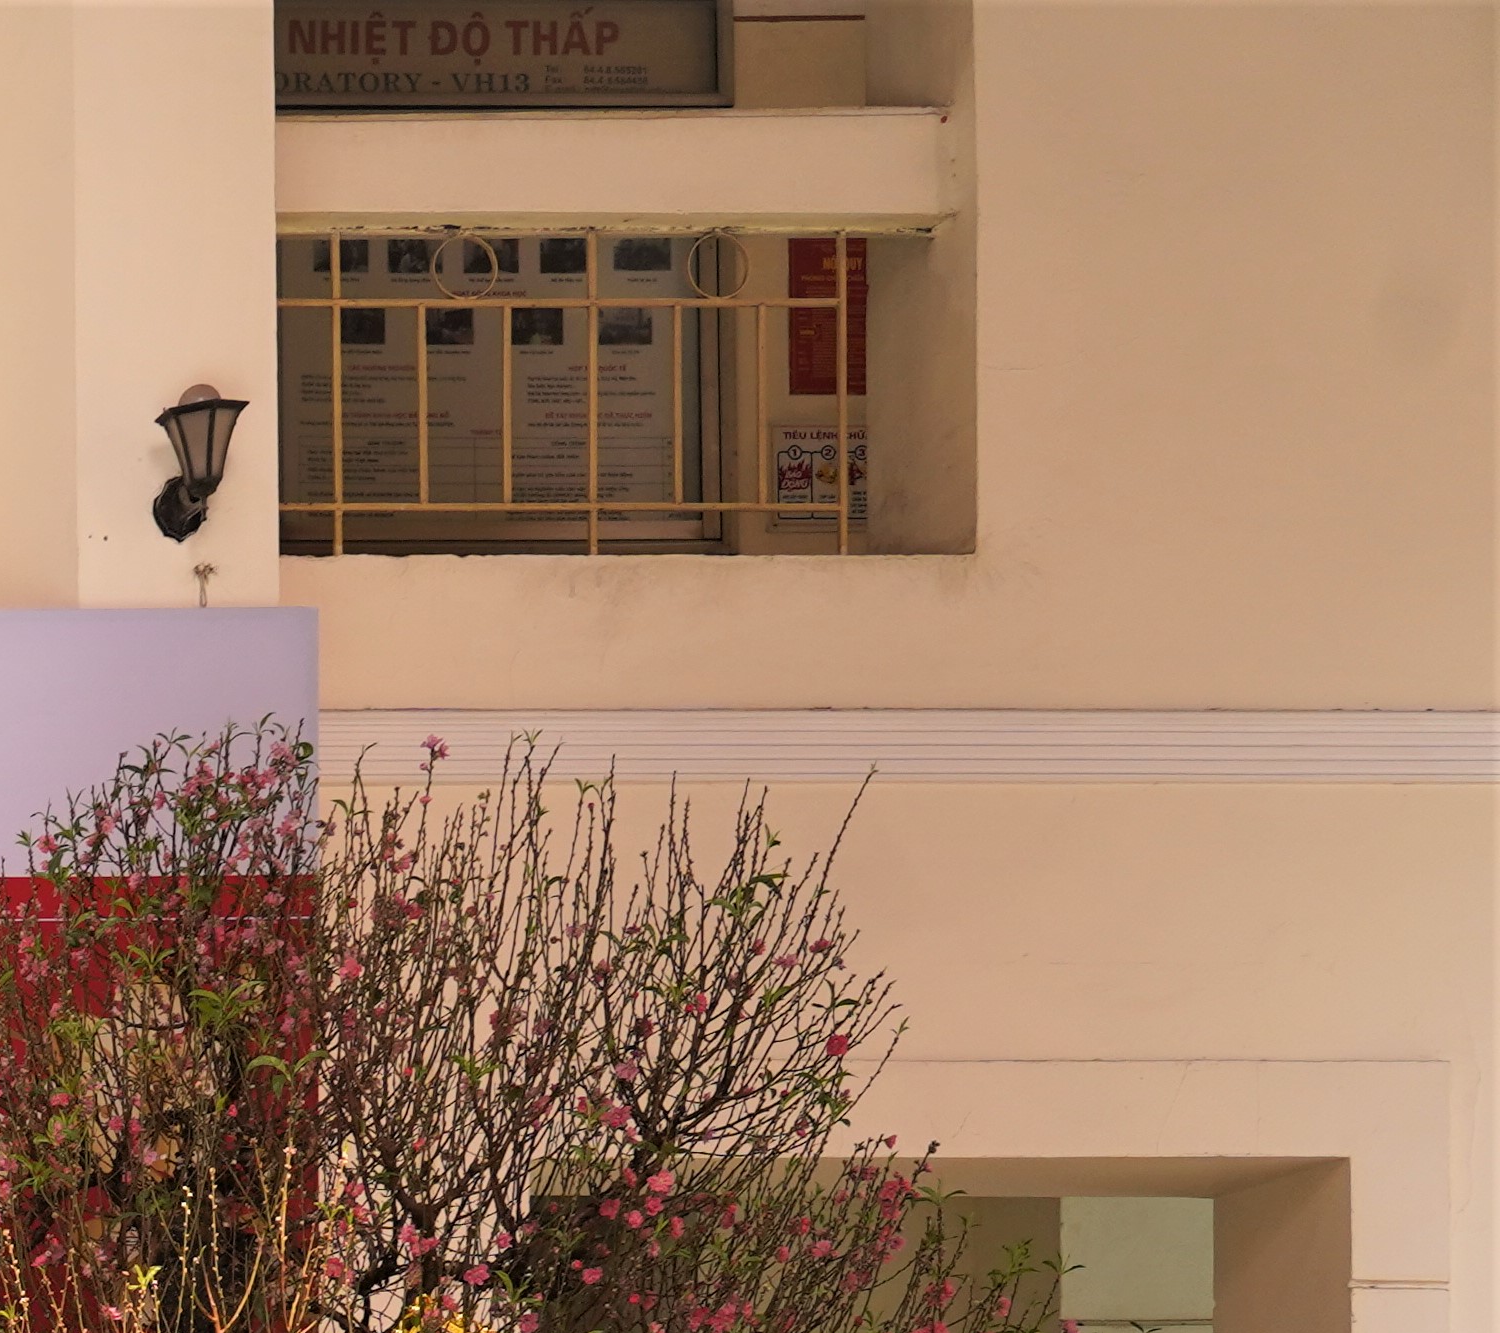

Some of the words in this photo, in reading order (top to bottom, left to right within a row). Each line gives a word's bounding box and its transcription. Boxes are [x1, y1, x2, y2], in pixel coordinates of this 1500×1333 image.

[288, 11, 417, 65] NHIỆT
[428, 11, 491, 66] ĐỘ
[504, 6, 619, 56] THẤP
[452, 72, 530, 93] VH13
